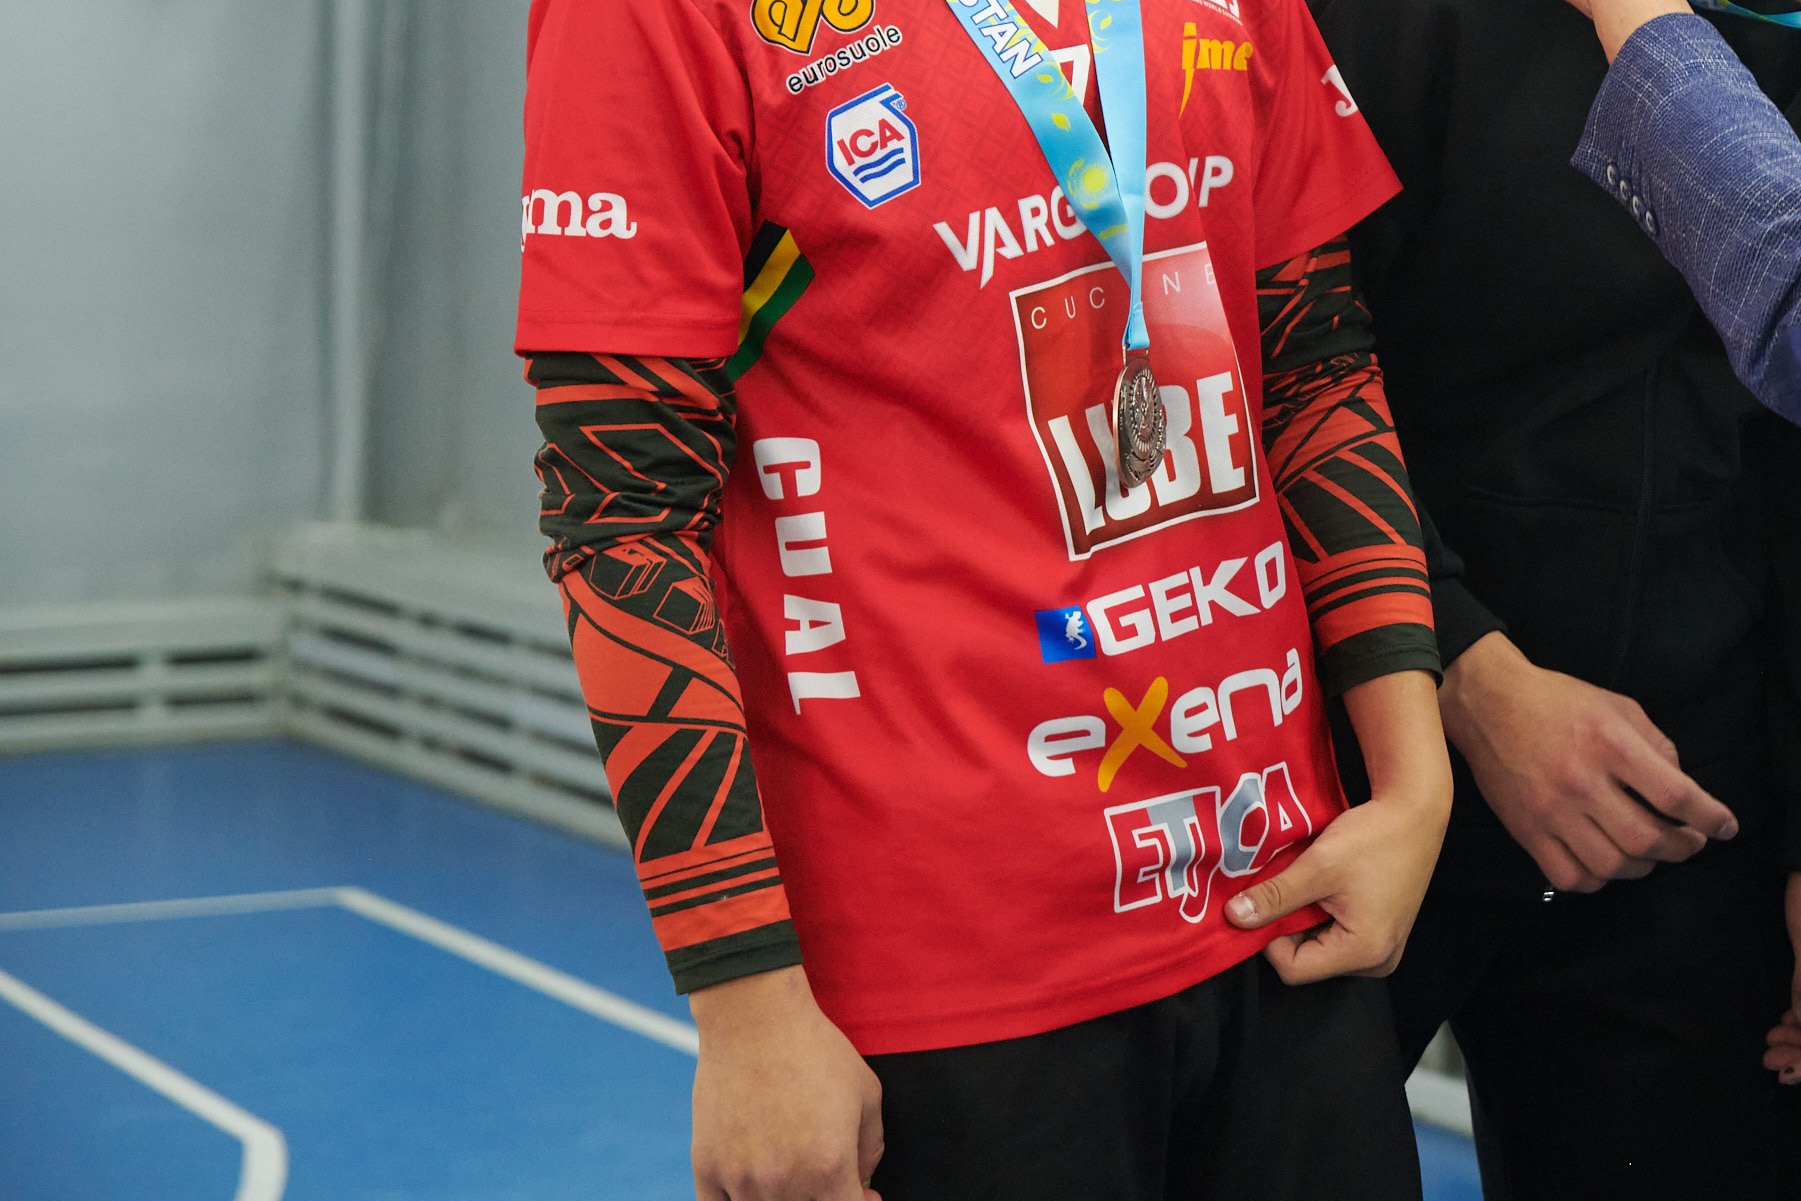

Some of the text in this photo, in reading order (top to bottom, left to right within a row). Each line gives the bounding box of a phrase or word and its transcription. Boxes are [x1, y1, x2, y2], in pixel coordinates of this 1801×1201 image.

[787, 26, 903, 94] eurosuole
[836, 118, 905, 166] ICA
[1031, 263, 1217, 330] CUCNE
[1086, 541, 1286, 656] GEKO
